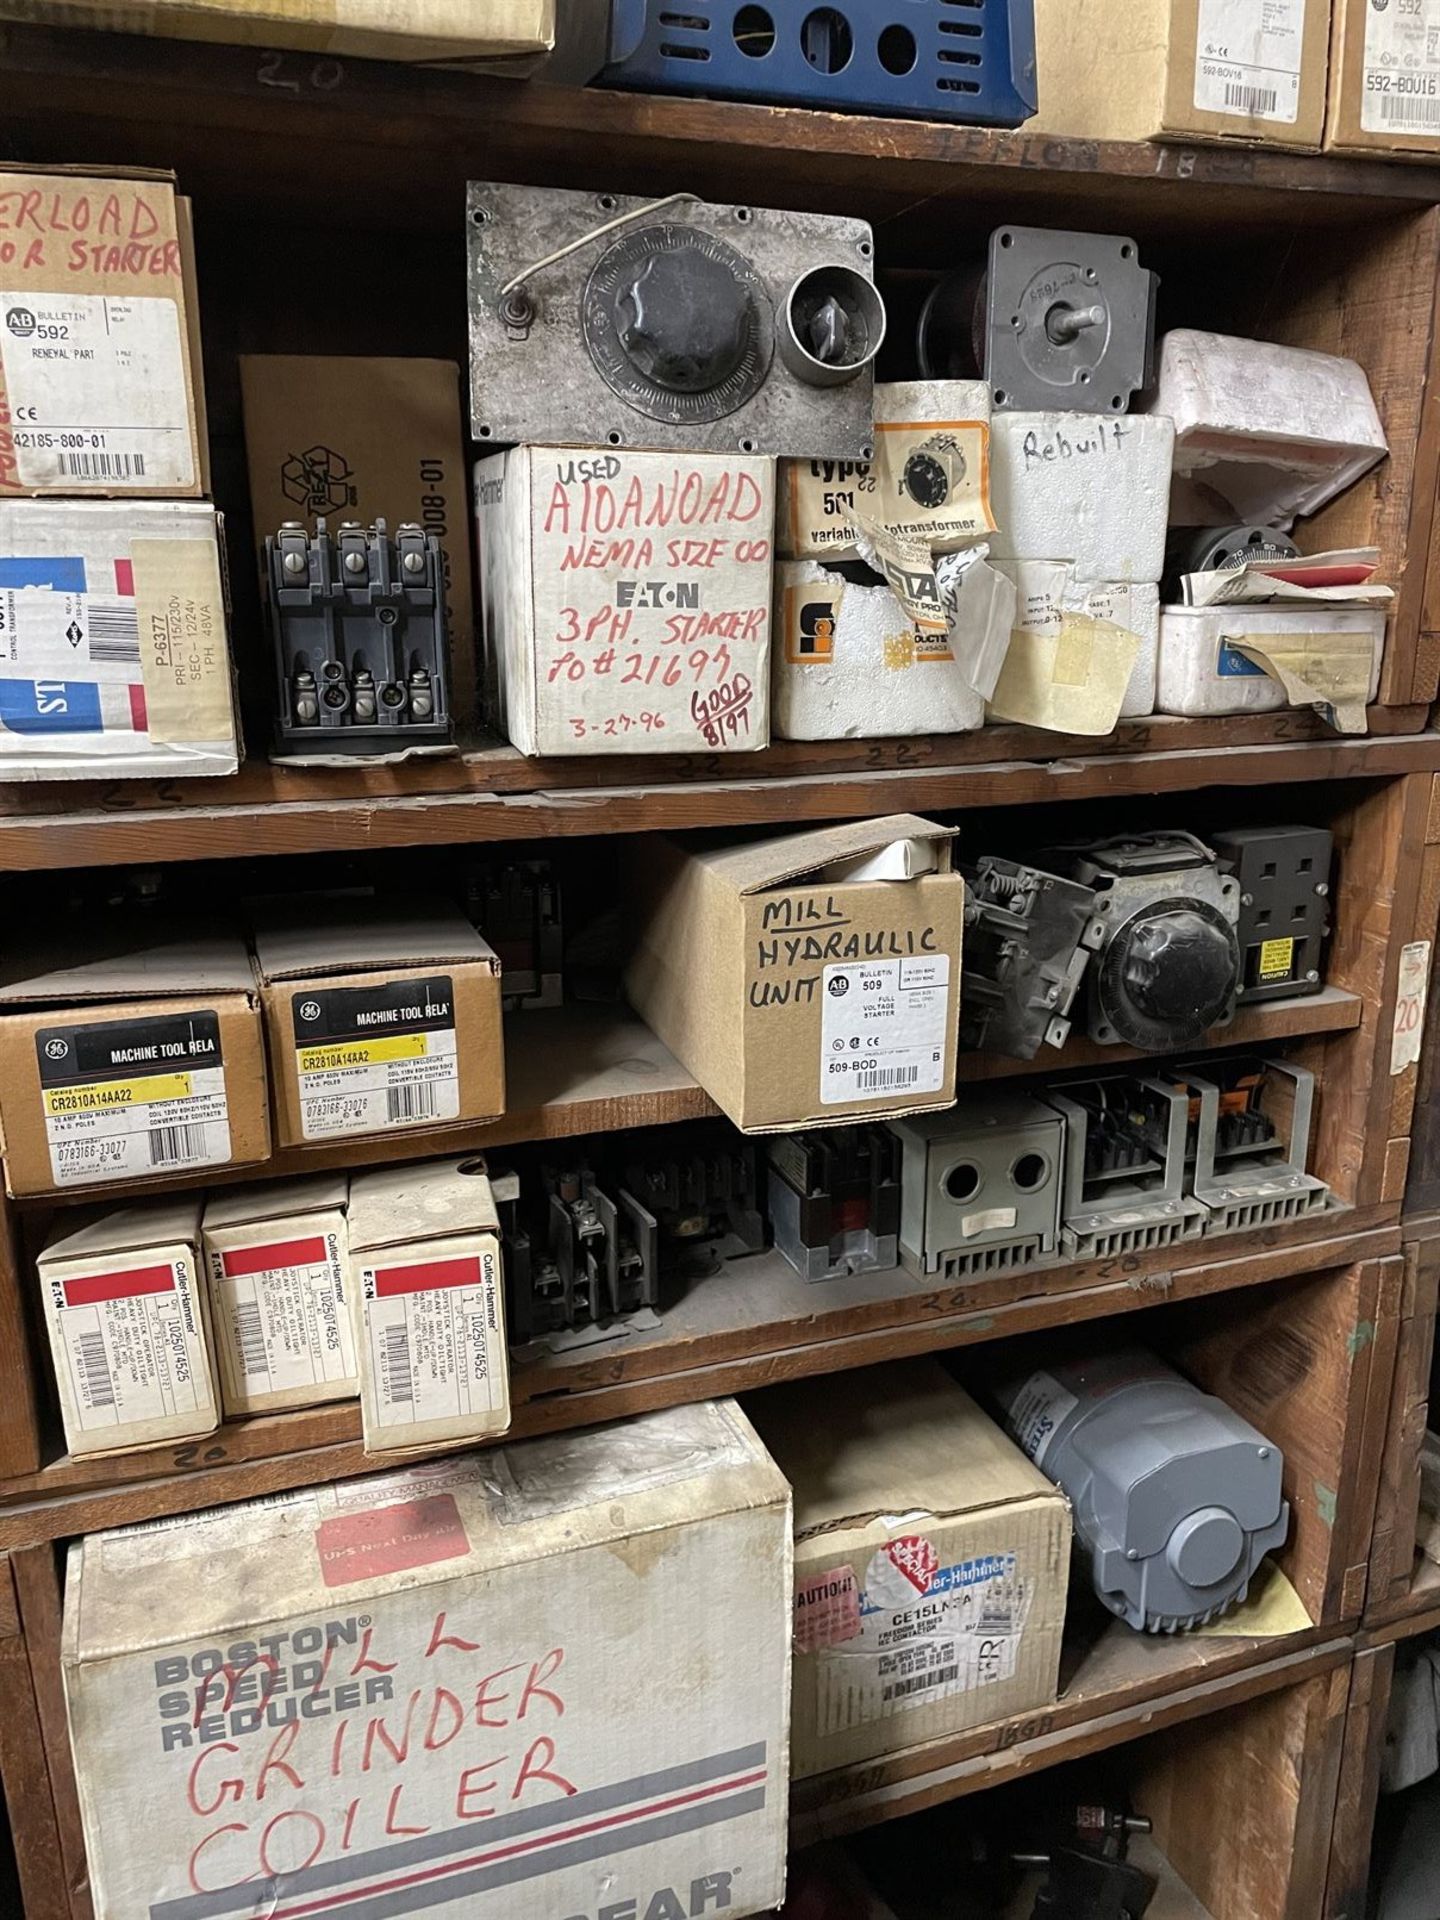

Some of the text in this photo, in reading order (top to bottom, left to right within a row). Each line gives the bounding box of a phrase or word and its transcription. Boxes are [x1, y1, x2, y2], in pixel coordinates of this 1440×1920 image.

[68, 239, 182, 276] STARTER
[37, 310, 86, 323] BULLETIN
[37, 325, 70, 340] 592
[32, 348, 95, 360] RENEWAL PART
[14, 433, 106, 449] 42185-800-01
[1023, 422, 1128, 471] Rebuilt
[557, 456, 621, 486] USED
[419, 459, 448, 537] 008-01
[811, 527, 861, 543] variabl
[884, 519, 976, 541] otransformer
[560, 536, 652, 571] NEMA
[667, 539, 729, 568] SIZE
[616, 581, 699, 608] EATON
[152, 615, 170, 667] P-6377
[661, 607, 767, 644] STARTER
[175, 664, 186, 686] PRI
[190, 654, 201, 681] SEC
[690, 673, 753, 724] GOOD
[762, 896, 843, 930] MILL
[758, 927, 937, 968] HYDRAULIC
[859, 970, 892, 978] BULLETIN
[863, 980, 882, 991] 509
[750, 976, 820, 1007] UNIT
[863, 1003, 894, 1011] VOLTAGE
[356, 1009, 398, 1026] MACHINE
[401, 1006, 423, 1020] TOOL
[864, 1010, 895, 1019] STARTER
[1395, 1001, 1421, 1034] 20
[111, 1039, 215, 1064] MACHINE TOOL RELA
[303, 1050, 369, 1070] CR2810A14AA2
[420, 1044, 424, 1053] 1
[933, 1052, 940, 1061] B
[829, 1059, 877, 1073] 509-BOD
[51, 1089, 132, 1111] CR2810A14AA22
[184, 1082, 189, 1093] 1
[95, 1108, 126, 1118] MAXIMUM
[150, 1111, 221, 1125] CONVERTIBLE CONTACTS
[58, 1141, 126, 1161] 0783166-33077
[175, 1262, 195, 1334] Cutler-Hammer
[435, 1290, 443, 1315] HEAVY
[483, 1254, 496, 1329] Cutler-Hammer
[320, 1290, 339, 1350] 10250T4525
[442, 1290, 454, 1373] JOYSTICK OPERATOR
[127, 1298, 148, 1387] HEAVY DUTY OILTIGHT
[135, 1298, 154, 1378] JOYSTICK OPERATOR
[168, 1320, 189, 1382] 10250T4525
[472, 1315, 487, 1380] 10250T4525
[437, 1345, 447, 1384] OILTIGHT
[930, 1558, 1006, 1590] er-Hammer
[797, 1576, 852, 1608] AUTION!
[154, 1616, 360, 1689] BOSTON
[194, 1611, 481, 1729] MILL
[158, 1659, 325, 1720] SPEED
[162, 1674, 394, 1752] REDUCER
[187, 1648, 565, 1816] GRINDER
[189, 1735, 578, 1894] COILER
